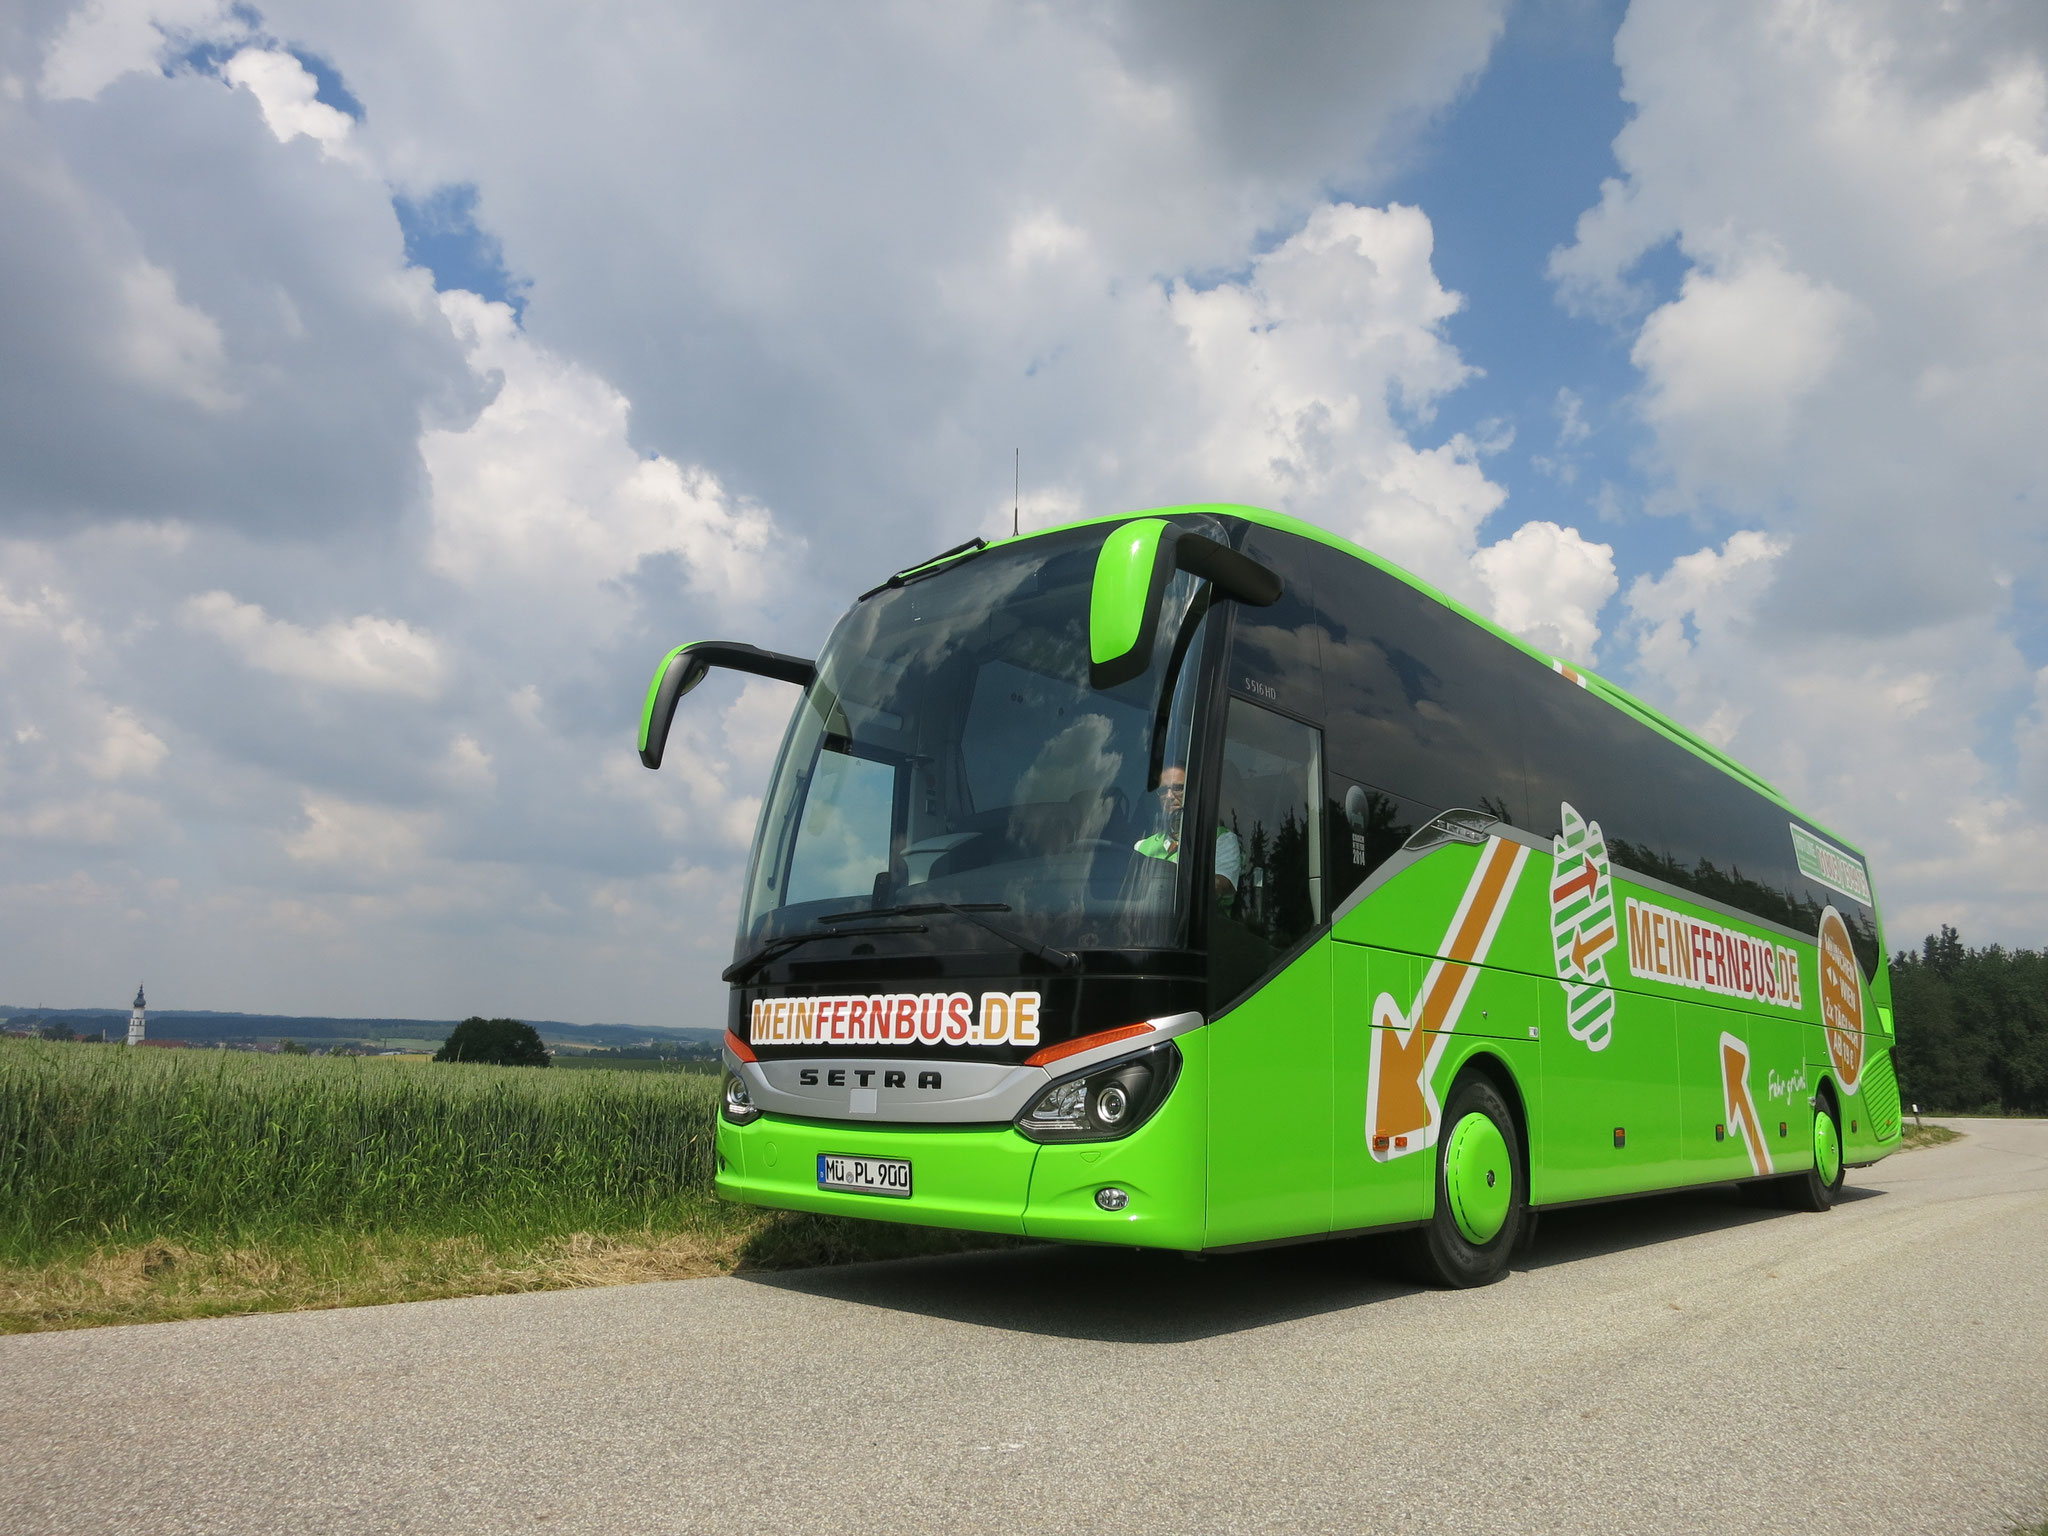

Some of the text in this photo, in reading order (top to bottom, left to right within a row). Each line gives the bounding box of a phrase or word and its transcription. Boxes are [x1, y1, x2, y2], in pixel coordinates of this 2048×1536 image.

[1245, 677, 1277, 700] S 516 HD
[1627, 904, 1801, 1004] MEINFERNBUS.DE
[751, 996, 1038, 1041] MEINFERNBUS.DE
[799, 1068, 942, 1089] SETRA
[826, 1159, 908, 1187] MÜ PL 900
